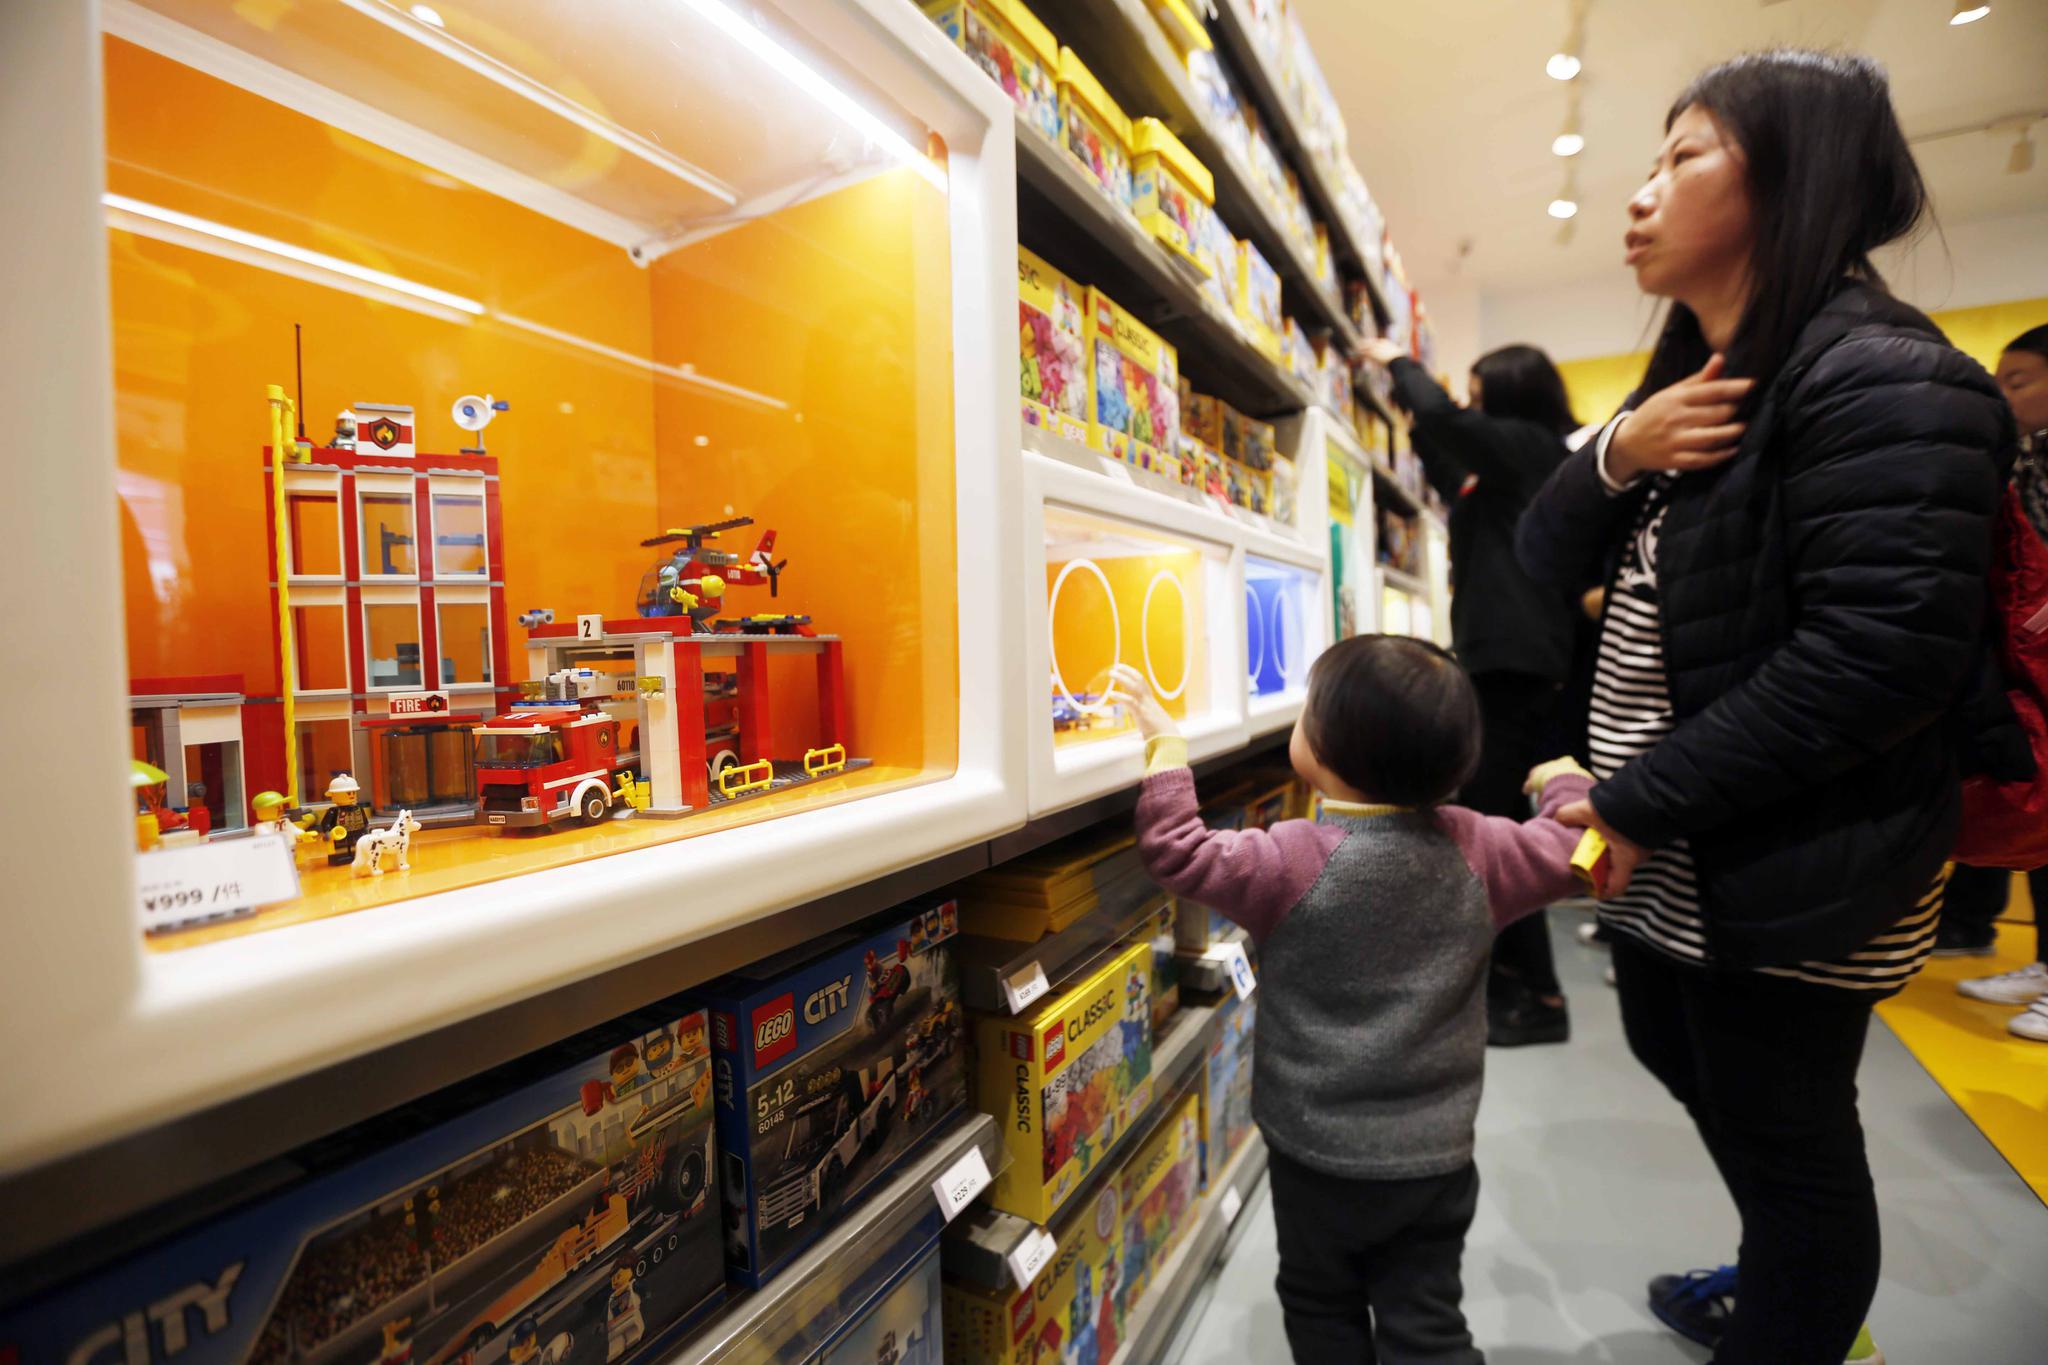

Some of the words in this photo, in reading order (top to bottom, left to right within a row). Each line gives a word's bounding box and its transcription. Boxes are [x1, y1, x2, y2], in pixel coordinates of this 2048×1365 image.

[583, 620, 591, 638] 2
[617, 680, 635, 691] 60110
[396, 698, 421, 712] FIRE
[756, 1009, 793, 1049] LEGO
[804, 973, 852, 1025] CITY
[1067, 990, 1114, 1042] CLASSIC
[718, 1016, 728, 1046] LEGO
[717, 1058, 735, 1110] CITY
[757, 1080, 795, 1118] 5-12
[1016, 1065, 1031, 1133] CLASSIC
[758, 1110, 785, 1134] 60148
